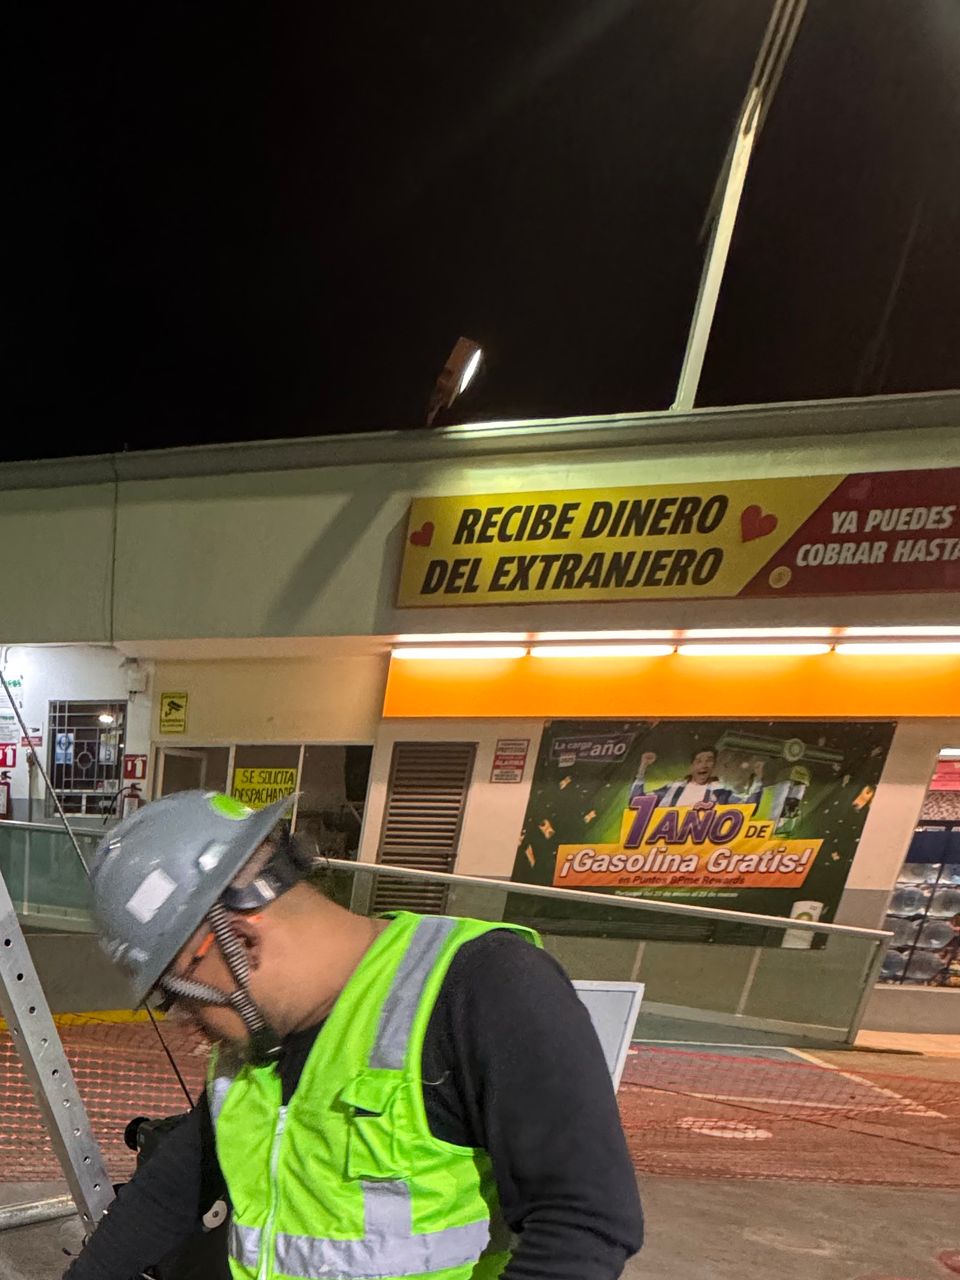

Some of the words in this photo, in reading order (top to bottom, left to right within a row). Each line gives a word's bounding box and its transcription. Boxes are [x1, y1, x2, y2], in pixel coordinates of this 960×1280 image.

[452, 502, 580, 545] RECIBE
[581, 494, 729, 539] DINERO
[831, 510, 858, 534] YA
[865, 505, 954, 532] PUEDES
[795, 542, 887, 567] COBRAR
[421, 557, 480, 594] DEL
[488, 547, 724, 592] EXTRANJERO
[590, 740, 627, 756] año
[241, 770, 255, 784] SE
[257, 771, 294, 784] SOLICITA
[624, 795, 658, 849] 1
[646, 801, 744, 844] AÑO
[744, 825, 768, 839] DE
[560, 846, 699, 877] ¡Gasolina
[707, 847, 812, 873] Gratis!
